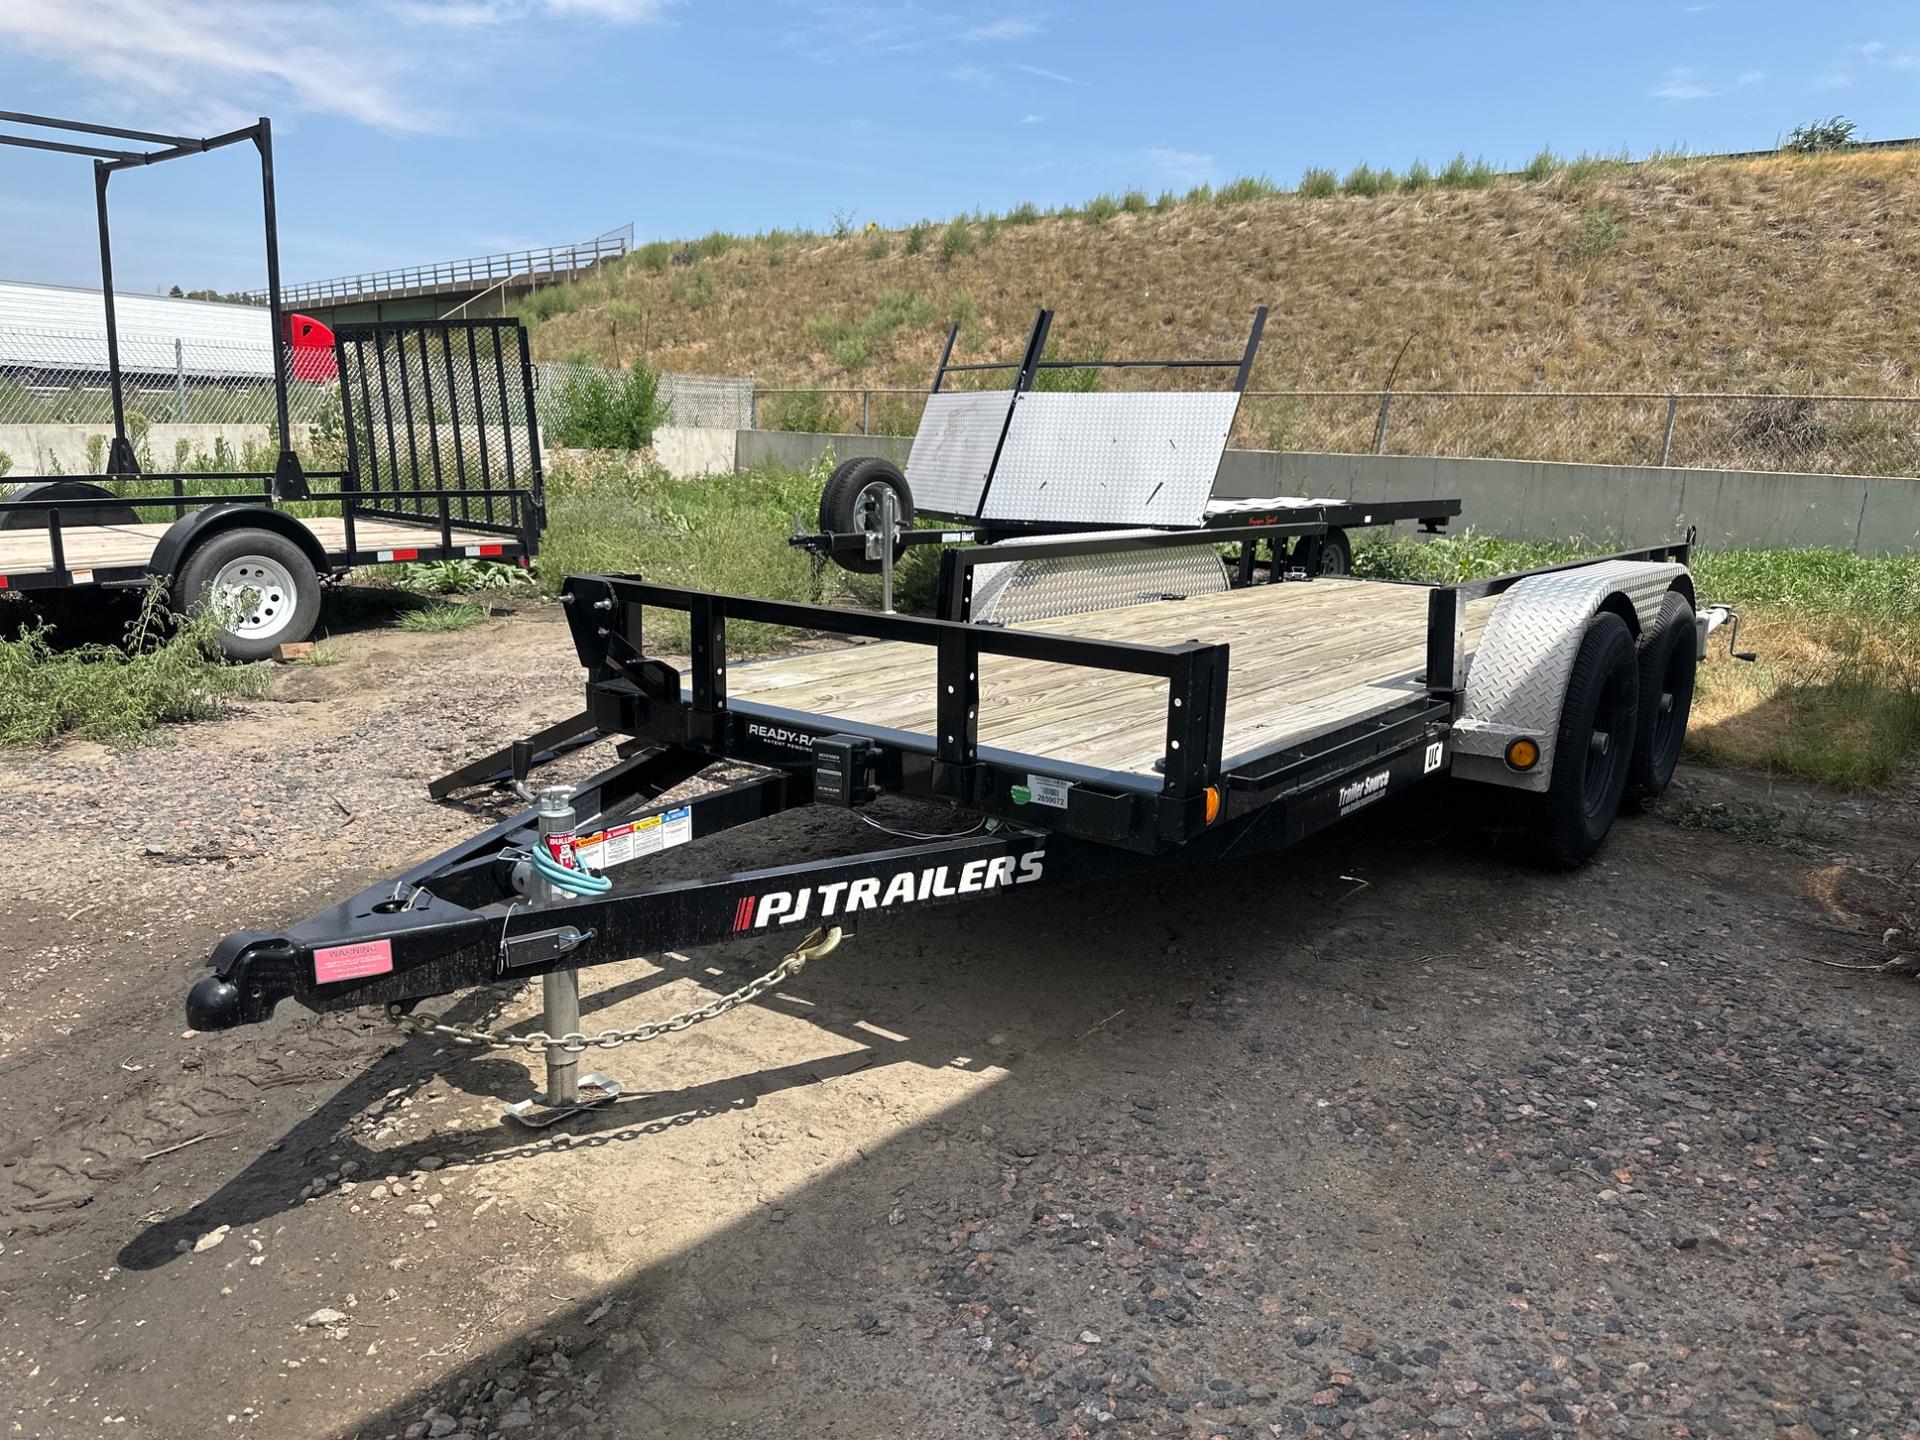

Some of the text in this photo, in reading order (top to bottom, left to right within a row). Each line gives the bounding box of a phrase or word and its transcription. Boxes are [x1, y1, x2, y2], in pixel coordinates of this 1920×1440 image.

[1338, 782, 1365, 807] Trailer
[1364, 770, 1390, 795] Source
[754, 850, 1045, 928] PJ TRAILERS
[329, 944, 377, 958] WARNING
